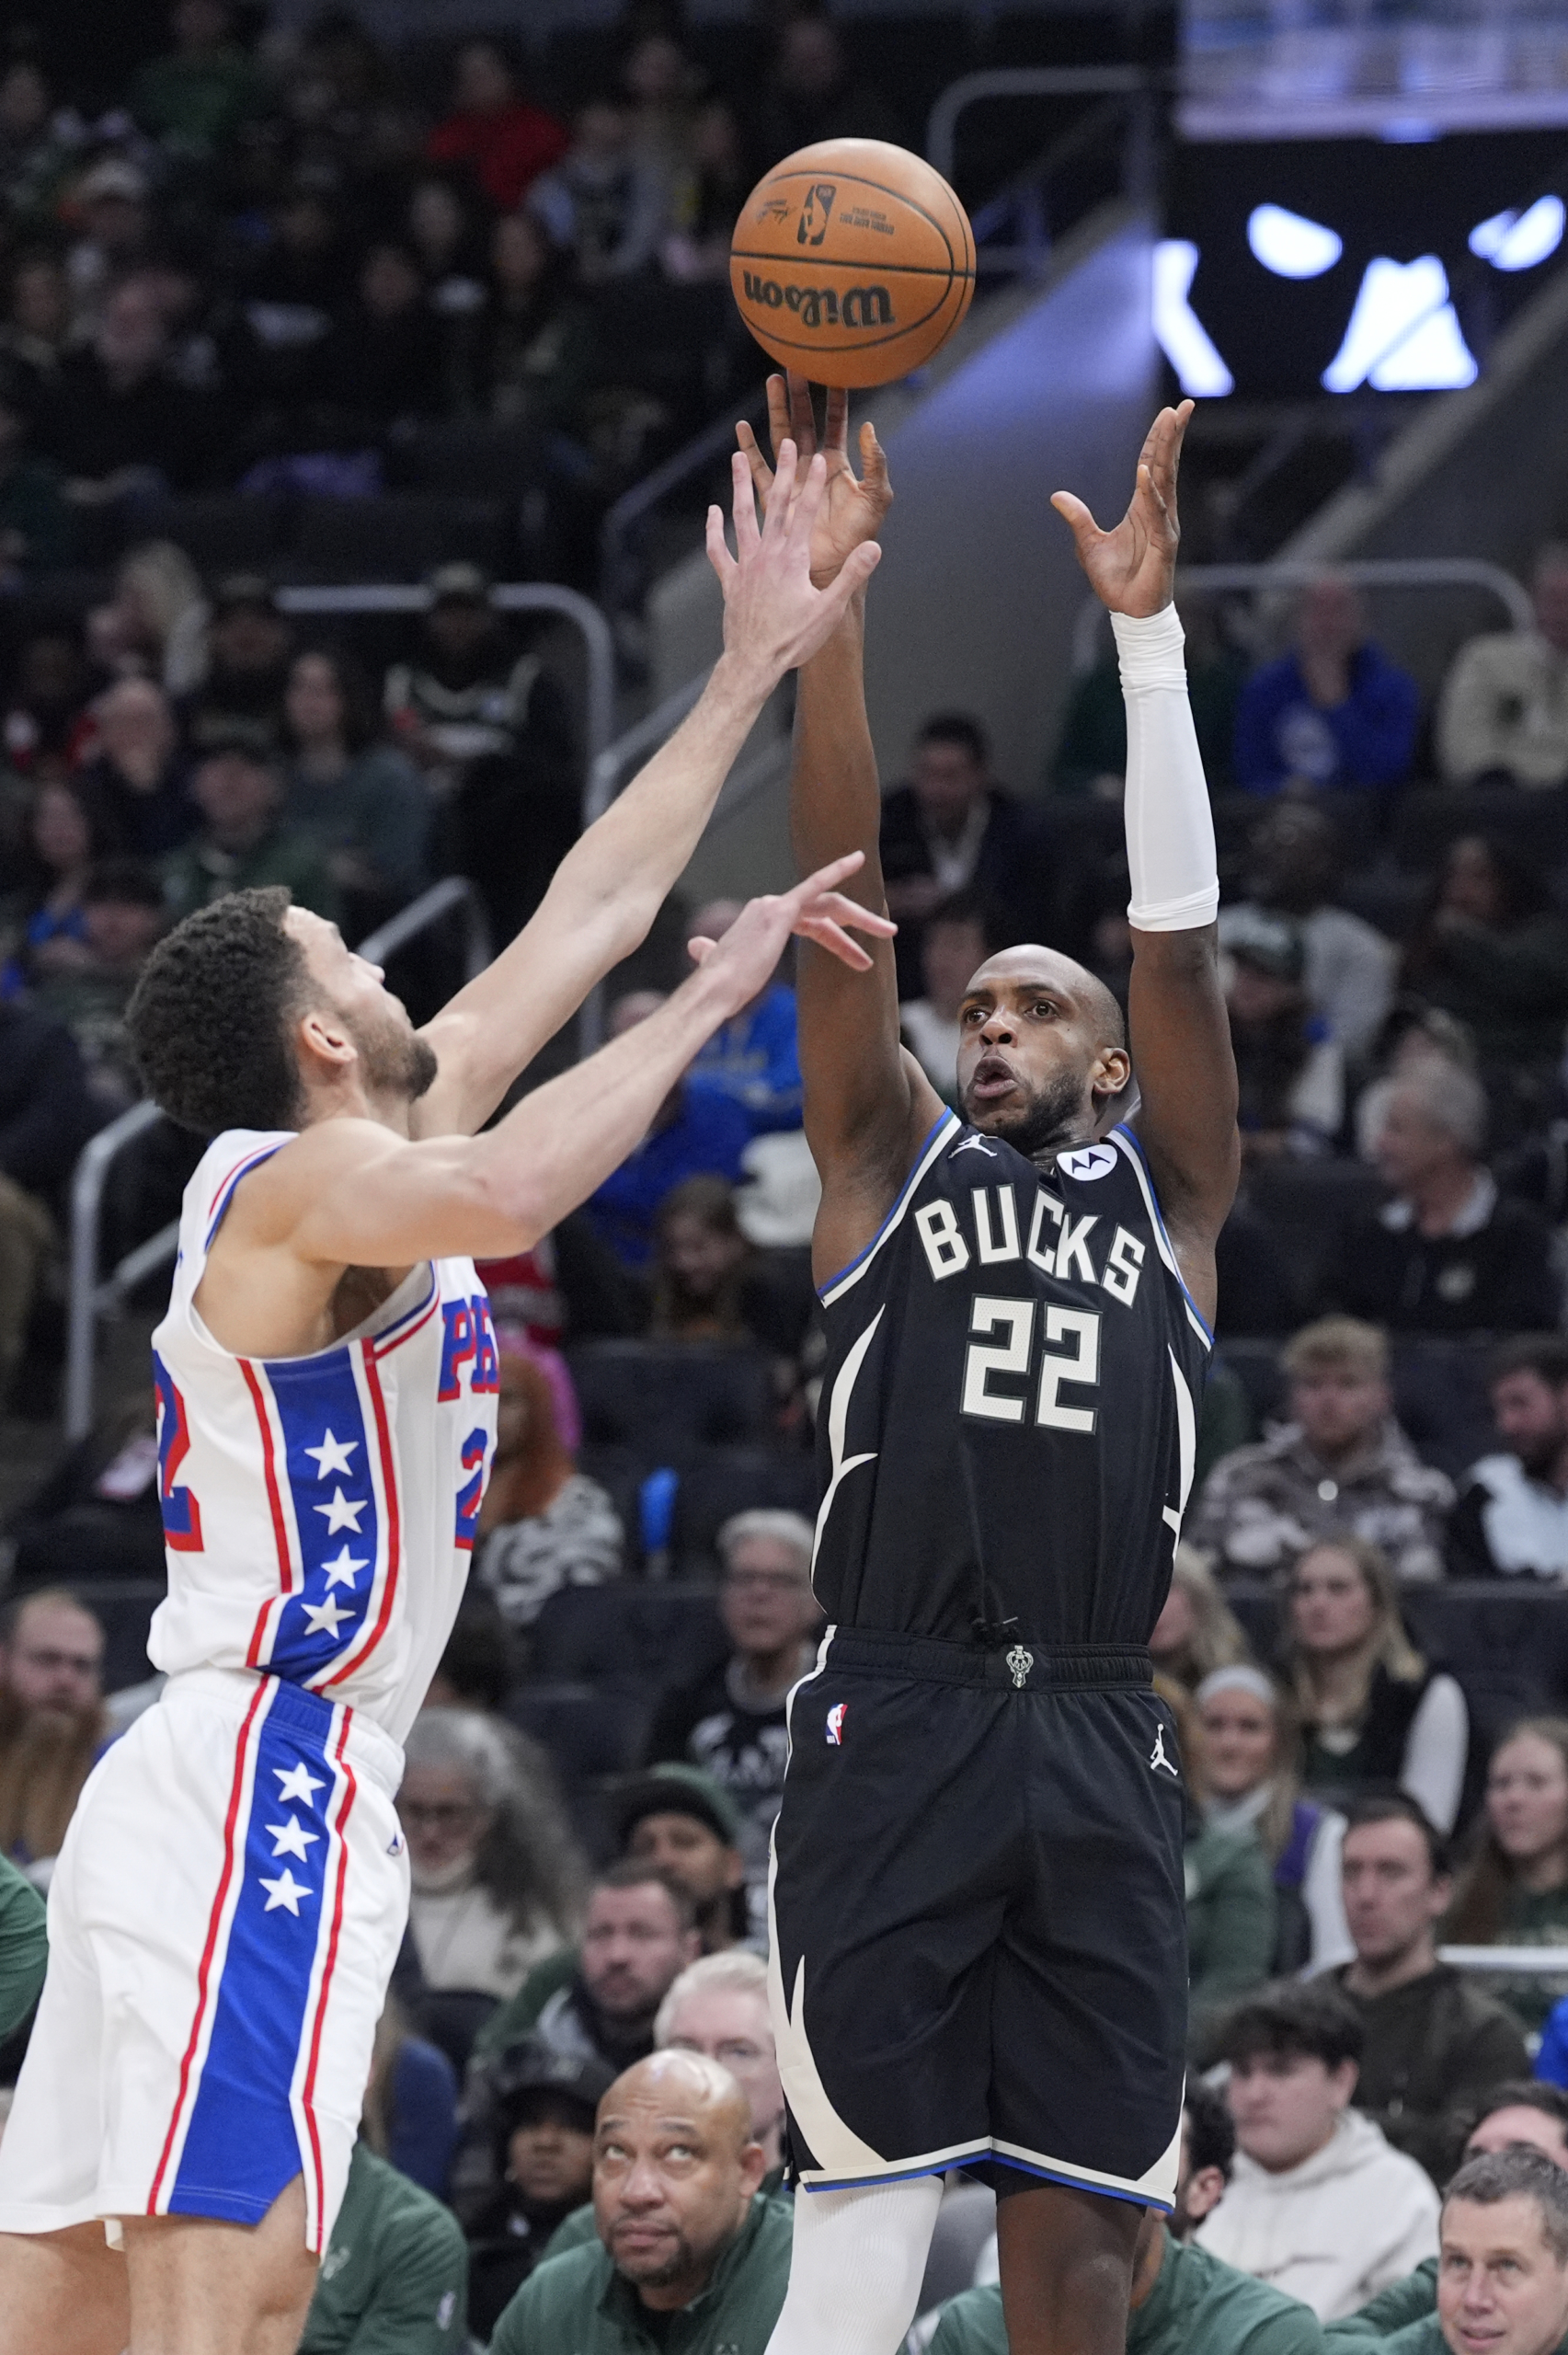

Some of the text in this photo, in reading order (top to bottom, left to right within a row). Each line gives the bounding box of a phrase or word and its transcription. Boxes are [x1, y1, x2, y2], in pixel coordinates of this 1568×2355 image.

[743, 270, 896, 327] Wilson
[914, 1183, 1146, 1308] BUCKS
[960, 1292, 1103, 1435] 22
[454, 1427, 496, 1551] 2
